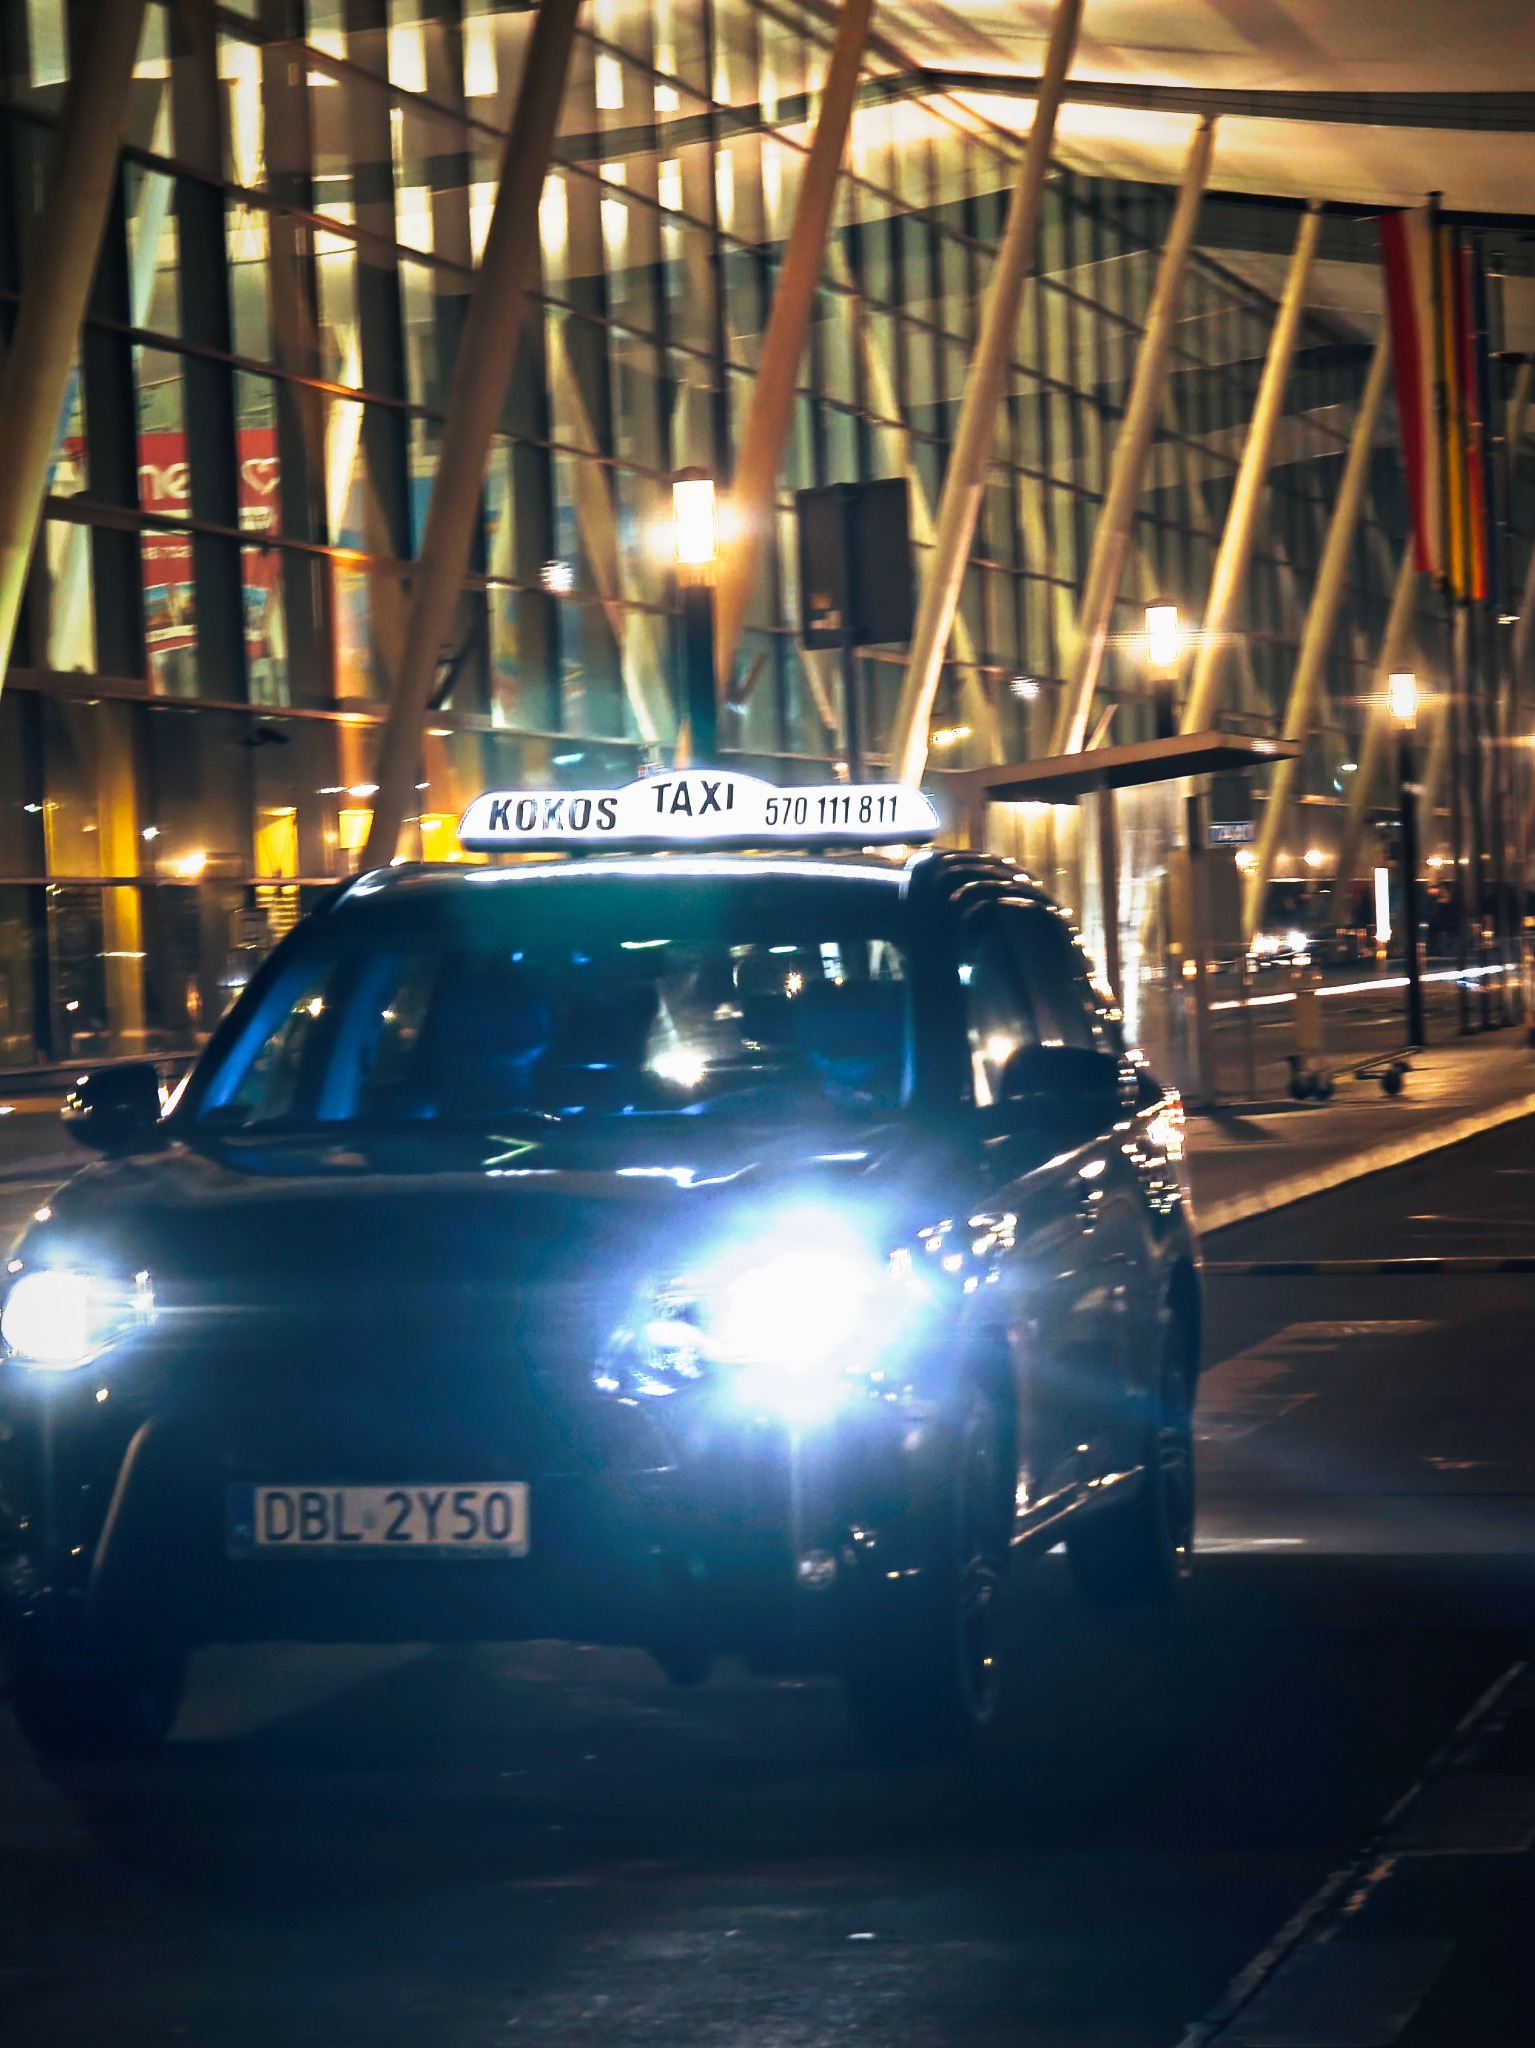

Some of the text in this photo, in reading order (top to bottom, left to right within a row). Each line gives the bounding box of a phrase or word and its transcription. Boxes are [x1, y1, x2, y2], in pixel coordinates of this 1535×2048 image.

[489, 780, 898, 831] KOKOS TAXI 570 111 811
[263, 1491, 513, 1541] DBL 2Y50
